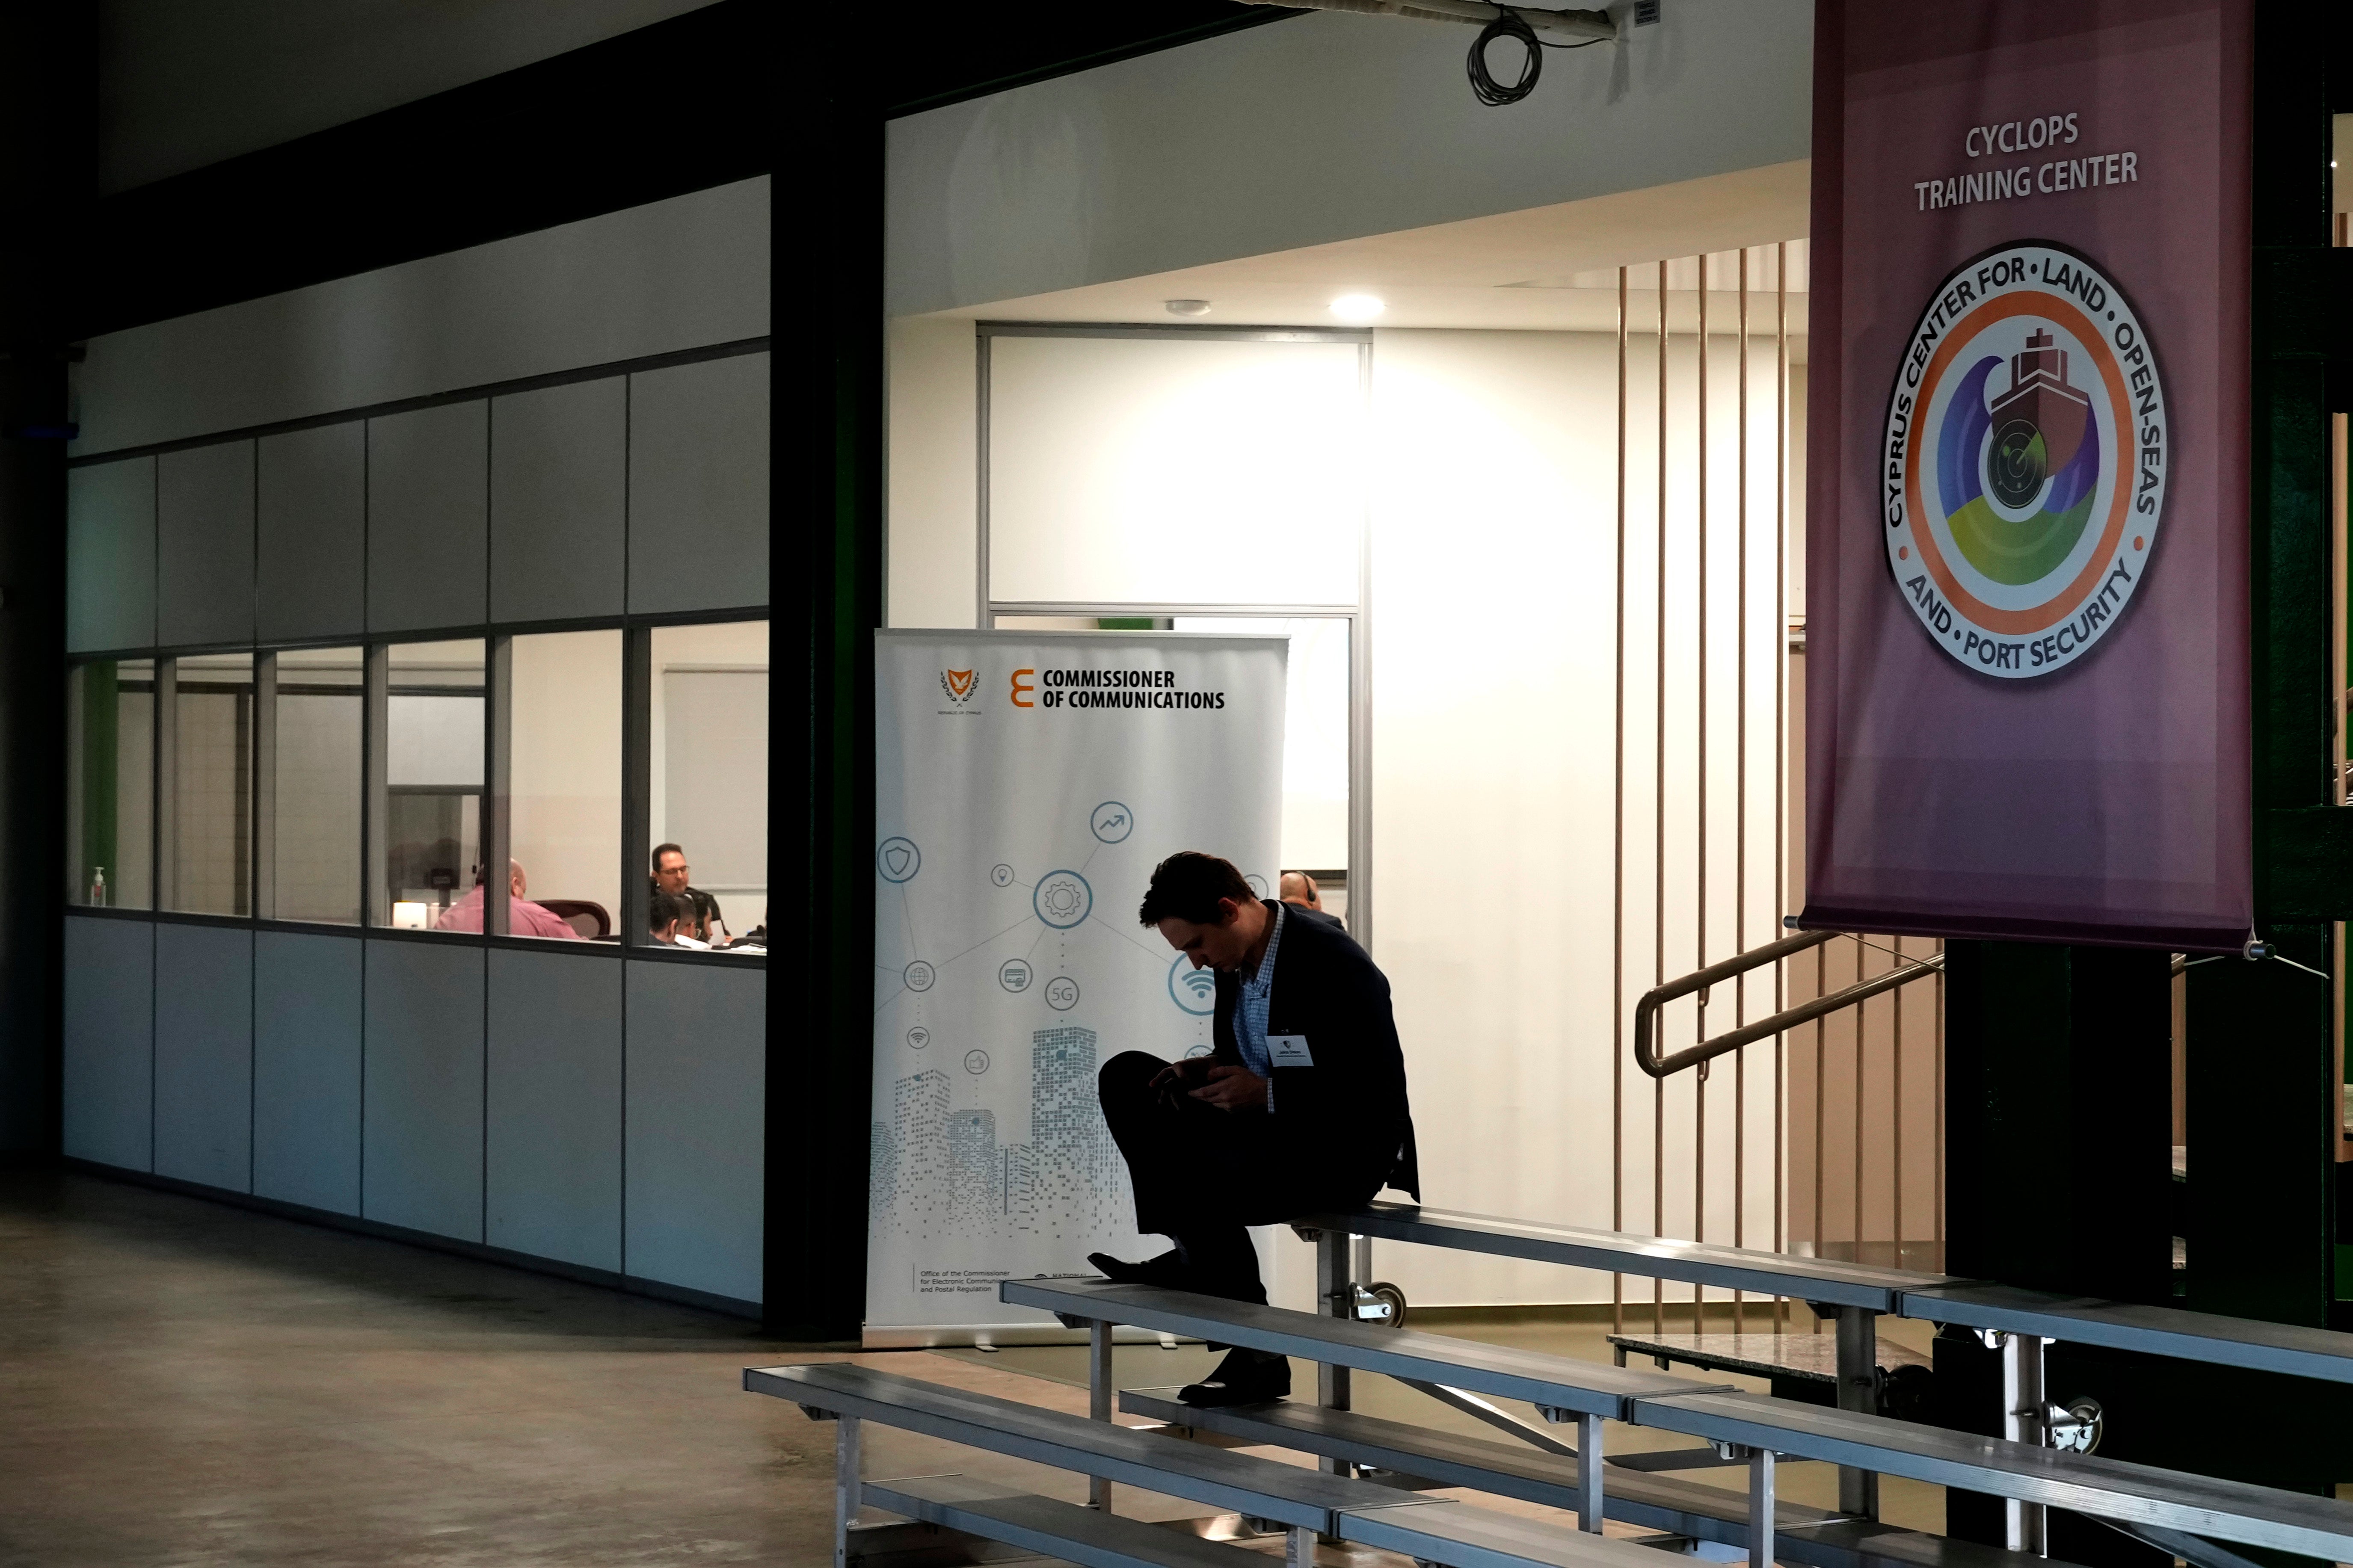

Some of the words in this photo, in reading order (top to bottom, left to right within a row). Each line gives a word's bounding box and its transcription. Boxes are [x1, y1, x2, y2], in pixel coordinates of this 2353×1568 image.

[1966, 112, 2078, 157] CYCLOPS
[1914, 166, 2031, 211] TRAINING
[2038, 151, 2138, 193] CENTER
[1888, 393, 1911, 528] CYPRUS
[1906, 280, 1977, 388] CENTER
[1977, 257, 2026, 295] FOR
[2042, 257, 2107, 312] LAND
[2115, 322, 2160, 515] OPEN-SEAS
[1906, 574, 1952, 634] AND
[1963, 631, 2025, 669] PORT
[2030, 557, 2132, 667] SECURITY
[1043, 670, 1175, 688] COMMISSIONER
[1043, 691, 1064, 708] OF
[1069, 691, 1224, 709] COMMUNICATIONS
[1052, 988, 1073, 1000] 5G
